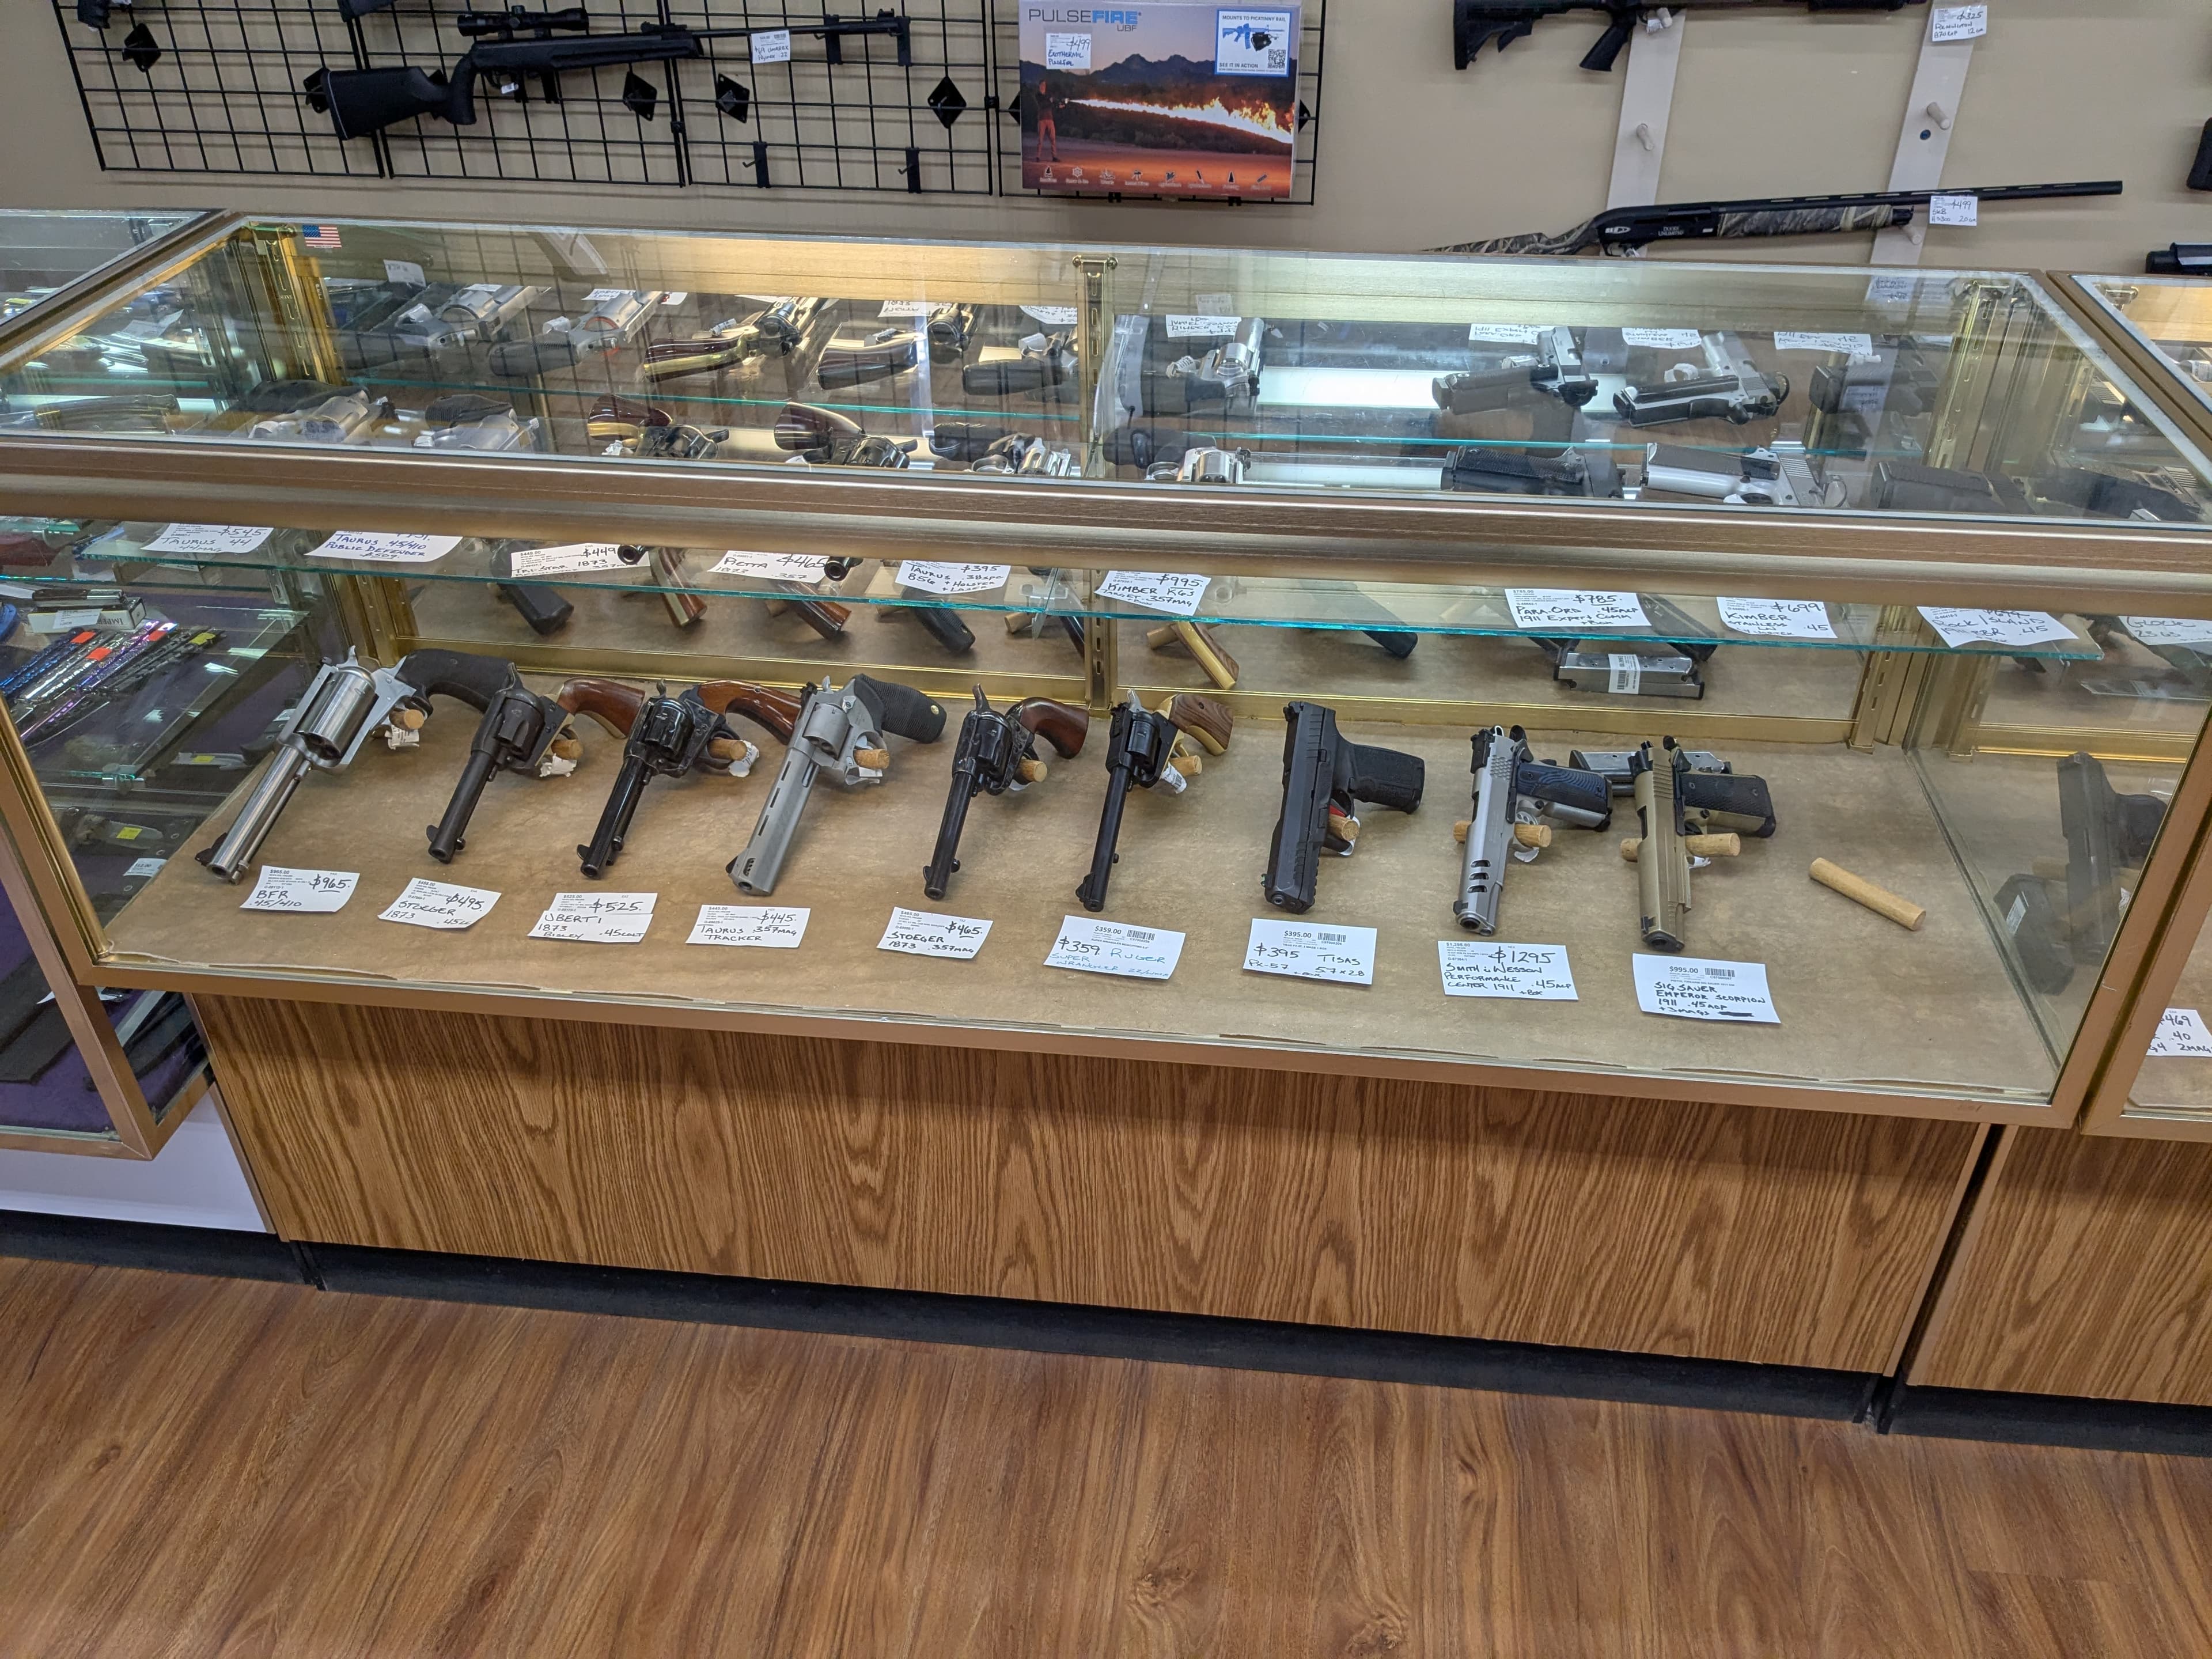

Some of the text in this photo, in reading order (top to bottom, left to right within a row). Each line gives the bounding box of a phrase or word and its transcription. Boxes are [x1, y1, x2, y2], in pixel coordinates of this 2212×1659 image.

[1029, 9, 1138, 24] PULSEFIRE
[1957, 11, 1983, 21] $325
[335, 534, 378, 545] TAURUS
[325, 542, 425, 556] PUBLIC DEFENDER
[582, 548, 616, 558] $449
[906, 562, 951, 580] TAURUS
[1108, 583, 1157, 594] KIMBER
[1100, 589, 1141, 599] TARGET
[1725, 611, 1791, 621] KIMBER
[1979, 615, 2045, 626] ISLAND
[256, 891, 289, 899] BFR
[399, 900, 456, 916] STOEGER
[386, 910, 415, 919] 1873
[544, 913, 602, 923] UBERTI
[697, 924, 744, 934] TAURUS
[1094, 926, 1122, 935] $359.00
[1284, 930, 1312, 938] $395.00
[887, 931, 944, 943] STOEGER
[1050, 953, 1090, 962] SUPER
[1110, 948, 1166, 964] RUGER
[1253, 942, 1361, 965] $395 TISAS
[1488, 946, 1555, 964] $1295
[1056, 961, 1119, 971] WRANGLER
[1446, 963, 1480, 972] SMITH
[1494, 963, 1542, 974] WESSON
[1444, 972, 1521, 982] PERFORMANCE
[1494, 983, 1514, 991] 1911
[1654, 982, 1718, 993] SIG SAUER
[1656, 990, 1766, 1003] EMPEROR SCORPION
